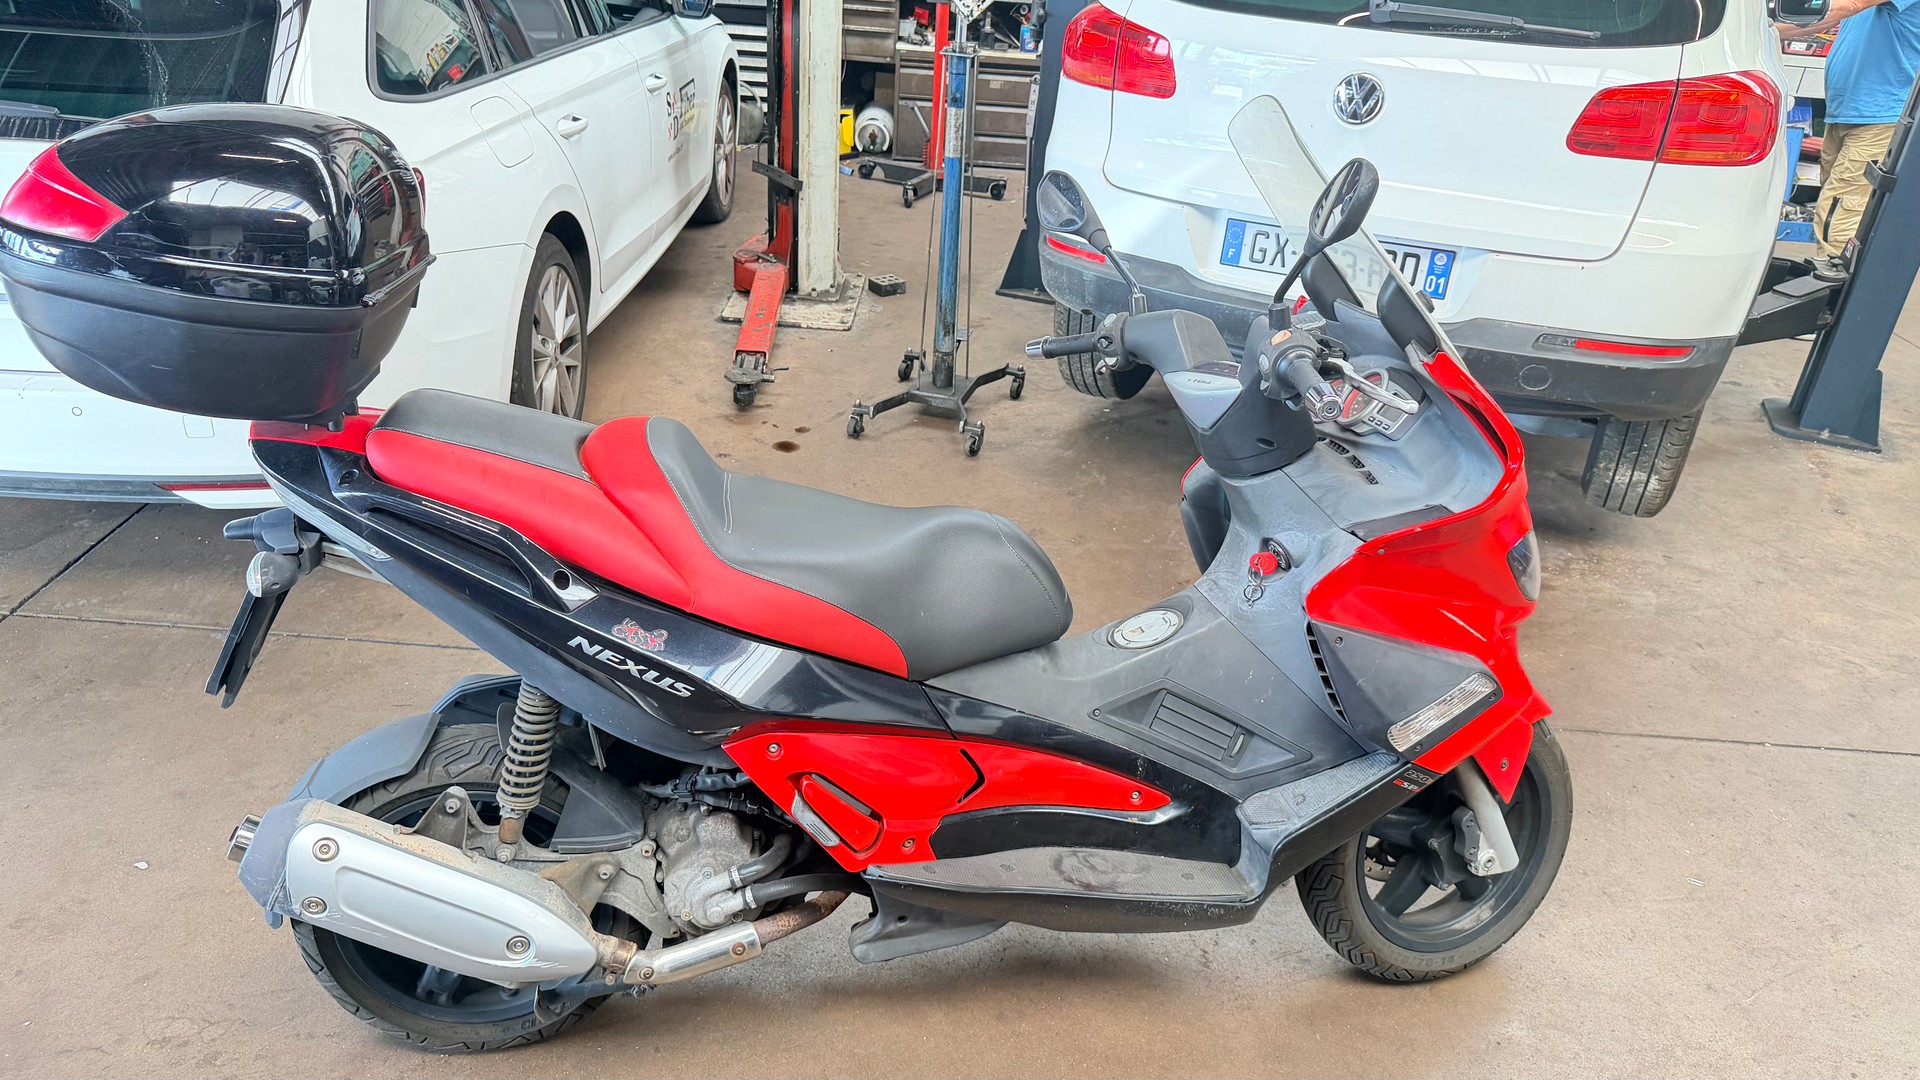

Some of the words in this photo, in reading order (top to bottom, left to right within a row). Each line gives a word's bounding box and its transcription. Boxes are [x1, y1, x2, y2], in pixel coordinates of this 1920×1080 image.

[1227, 248, 1236, 259] F
[1424, 274, 1446, 294] 01
[567, 635, 695, 698] NEXUS
